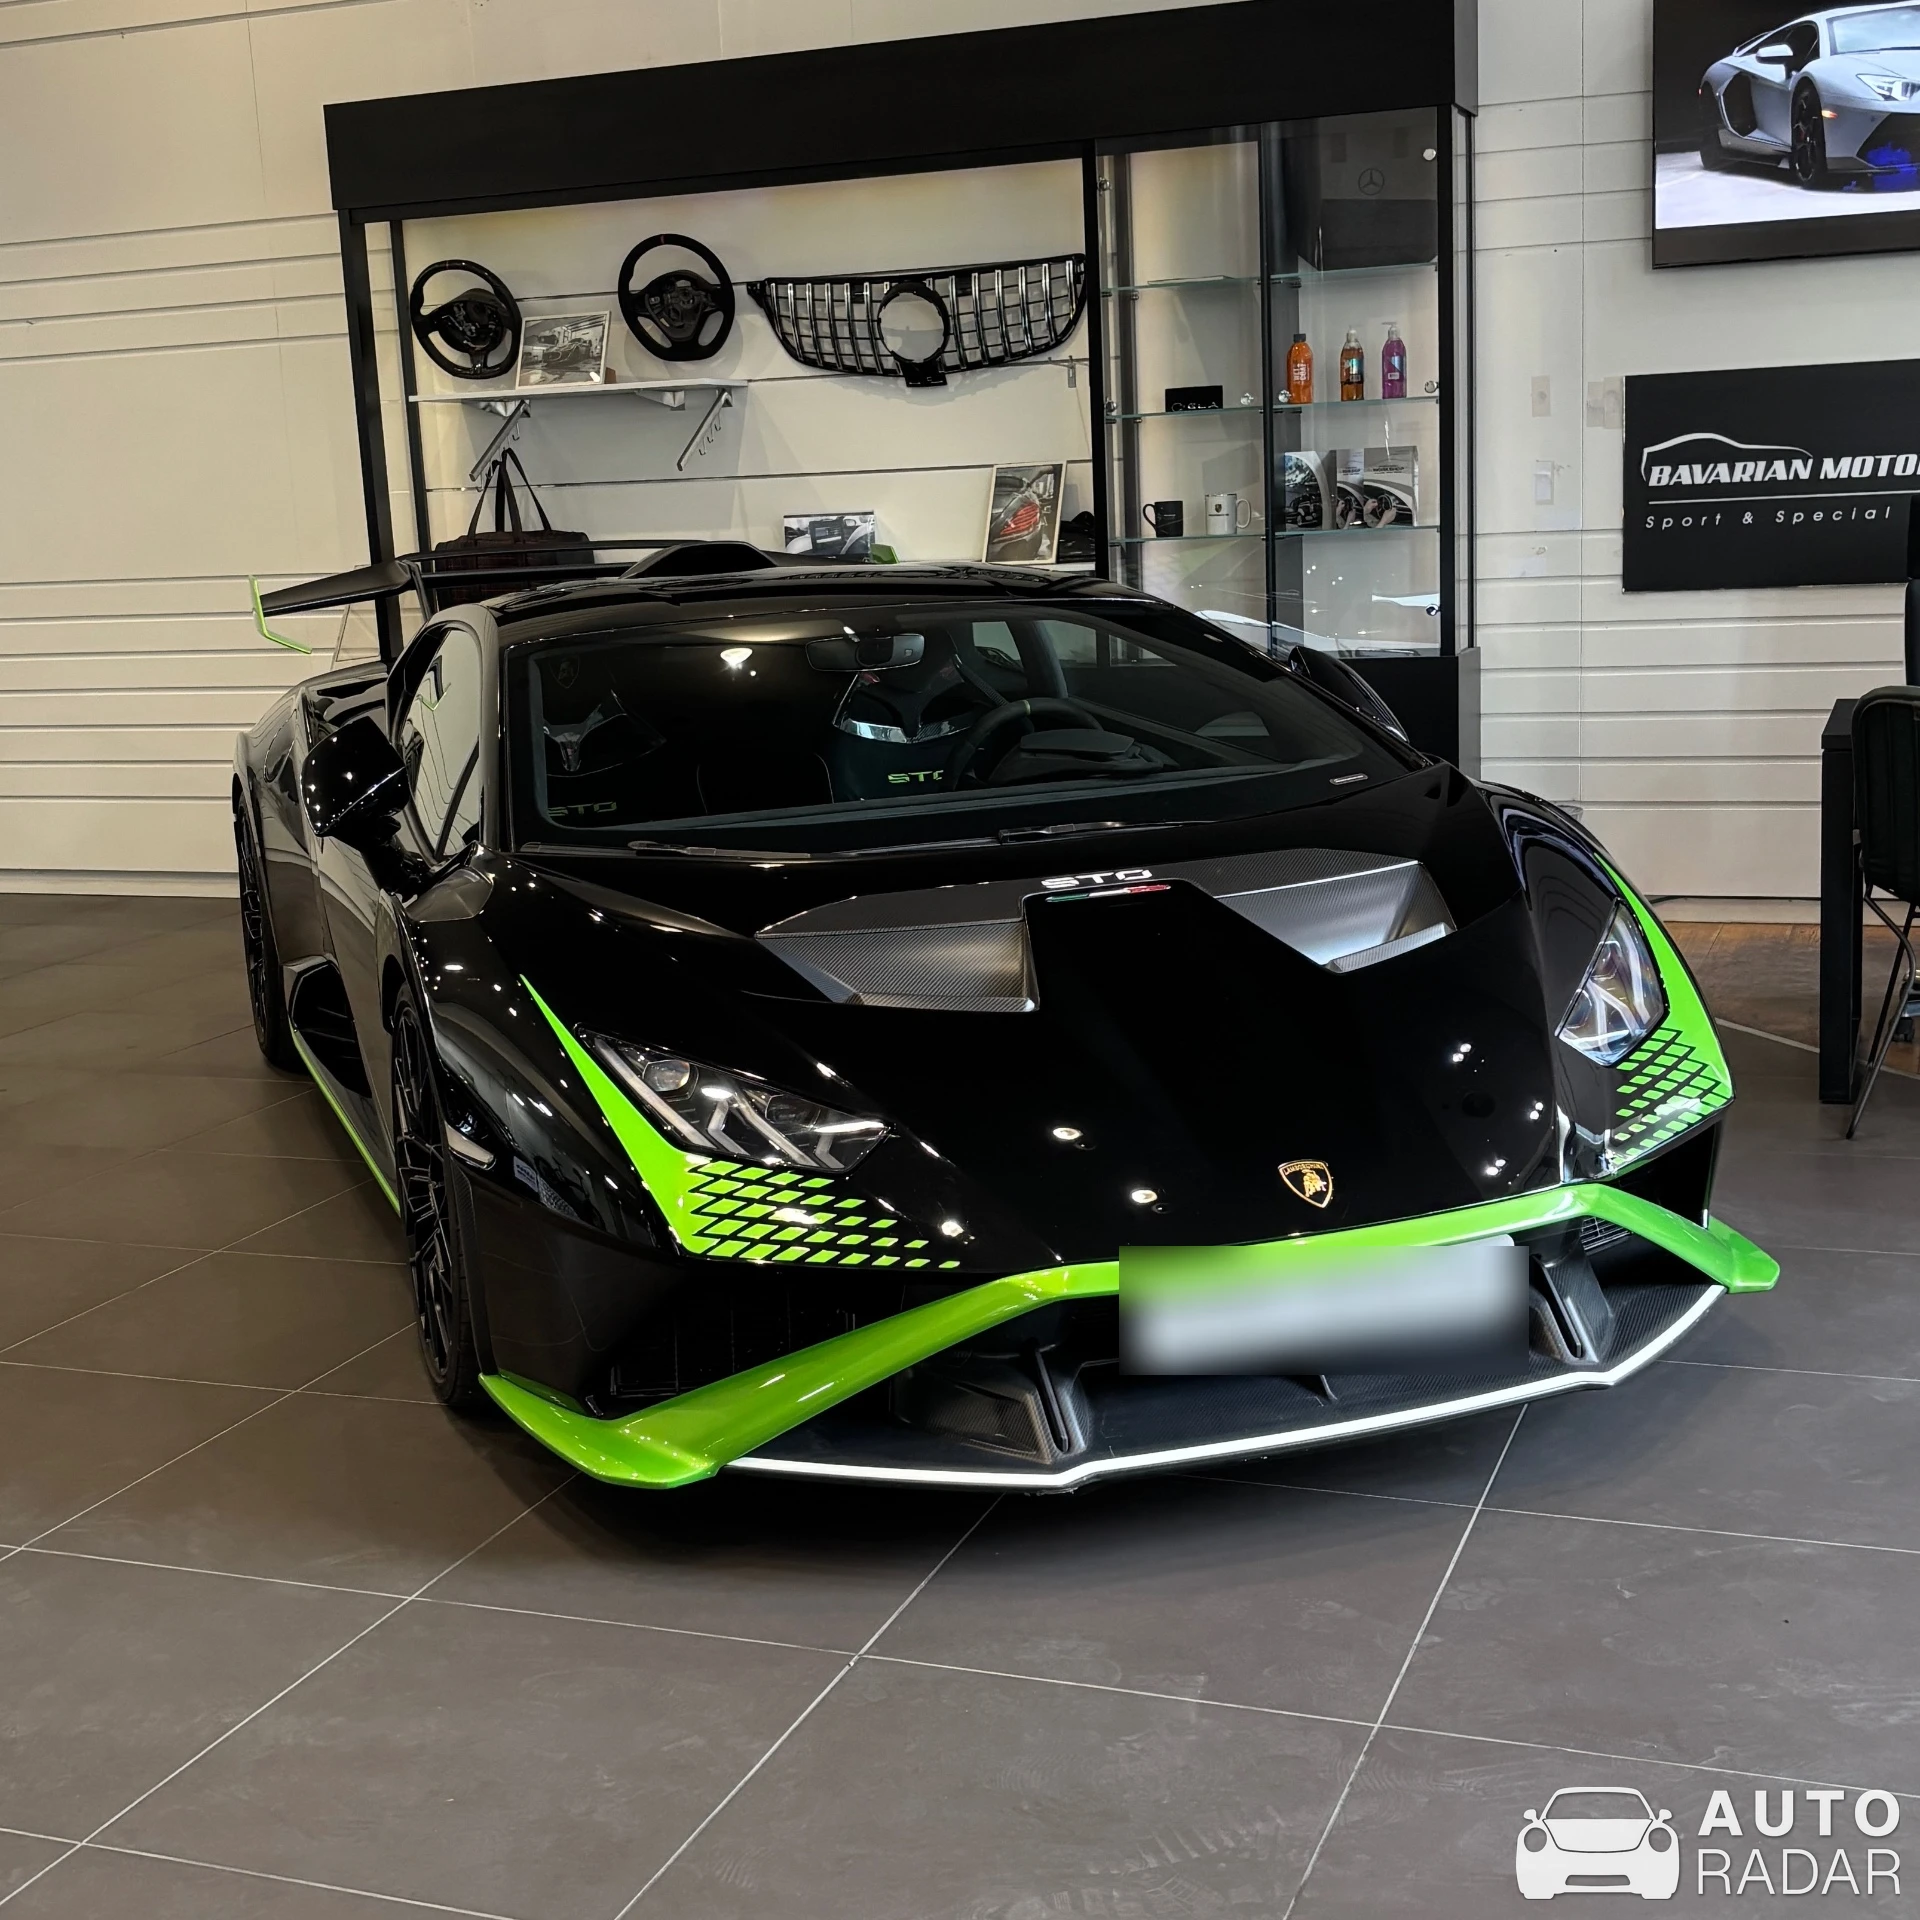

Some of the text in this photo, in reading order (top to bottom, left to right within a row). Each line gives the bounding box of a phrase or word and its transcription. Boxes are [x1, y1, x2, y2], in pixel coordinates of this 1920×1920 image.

[1649, 454, 1920, 486] BAVARIAN MOTO
[1645, 506, 1890, 530] Sport & Special
[547, 802, 617, 817] STO
[1041, 869, 1153, 888] STO
